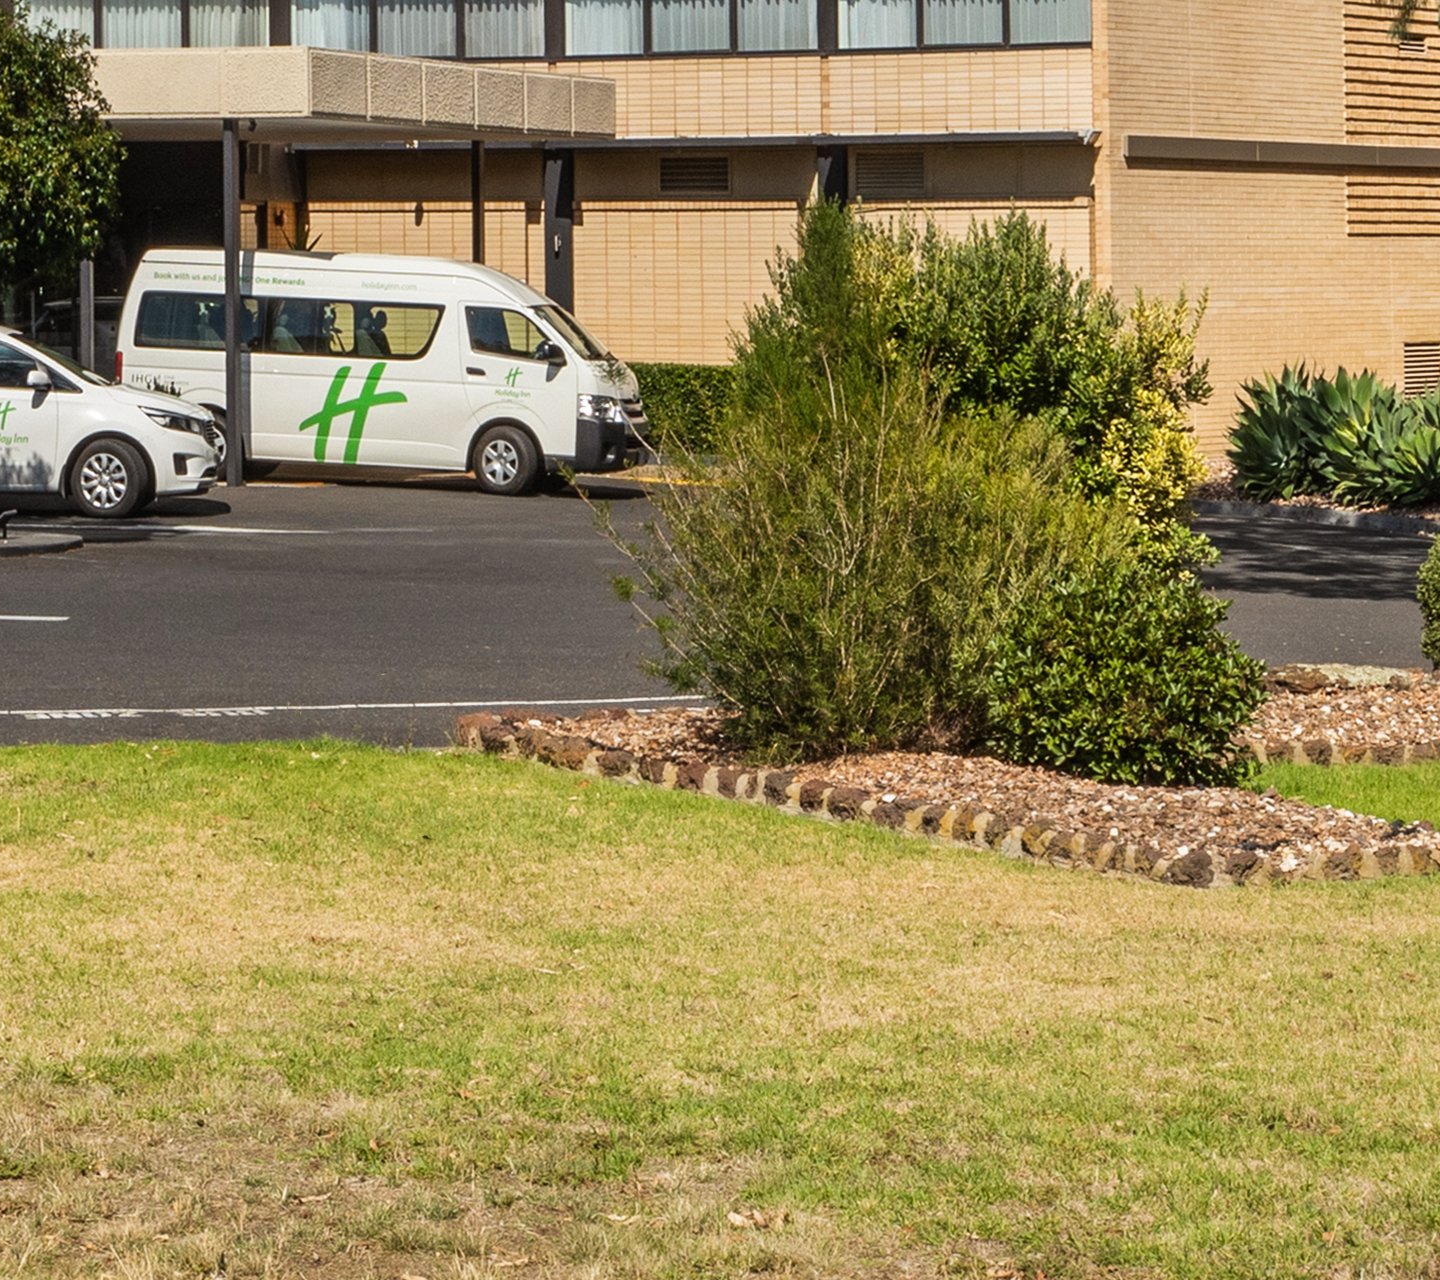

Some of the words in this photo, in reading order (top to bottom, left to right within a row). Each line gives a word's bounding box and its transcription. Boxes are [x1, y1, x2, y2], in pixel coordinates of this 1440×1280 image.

[154, 271, 171, 280] Book
[174, 272, 190, 280] with
[202, 274, 217, 282] and
[255, 276, 270, 284] One
[272, 277, 305, 286] Rewards
[13, 432, 30, 443] Inn
